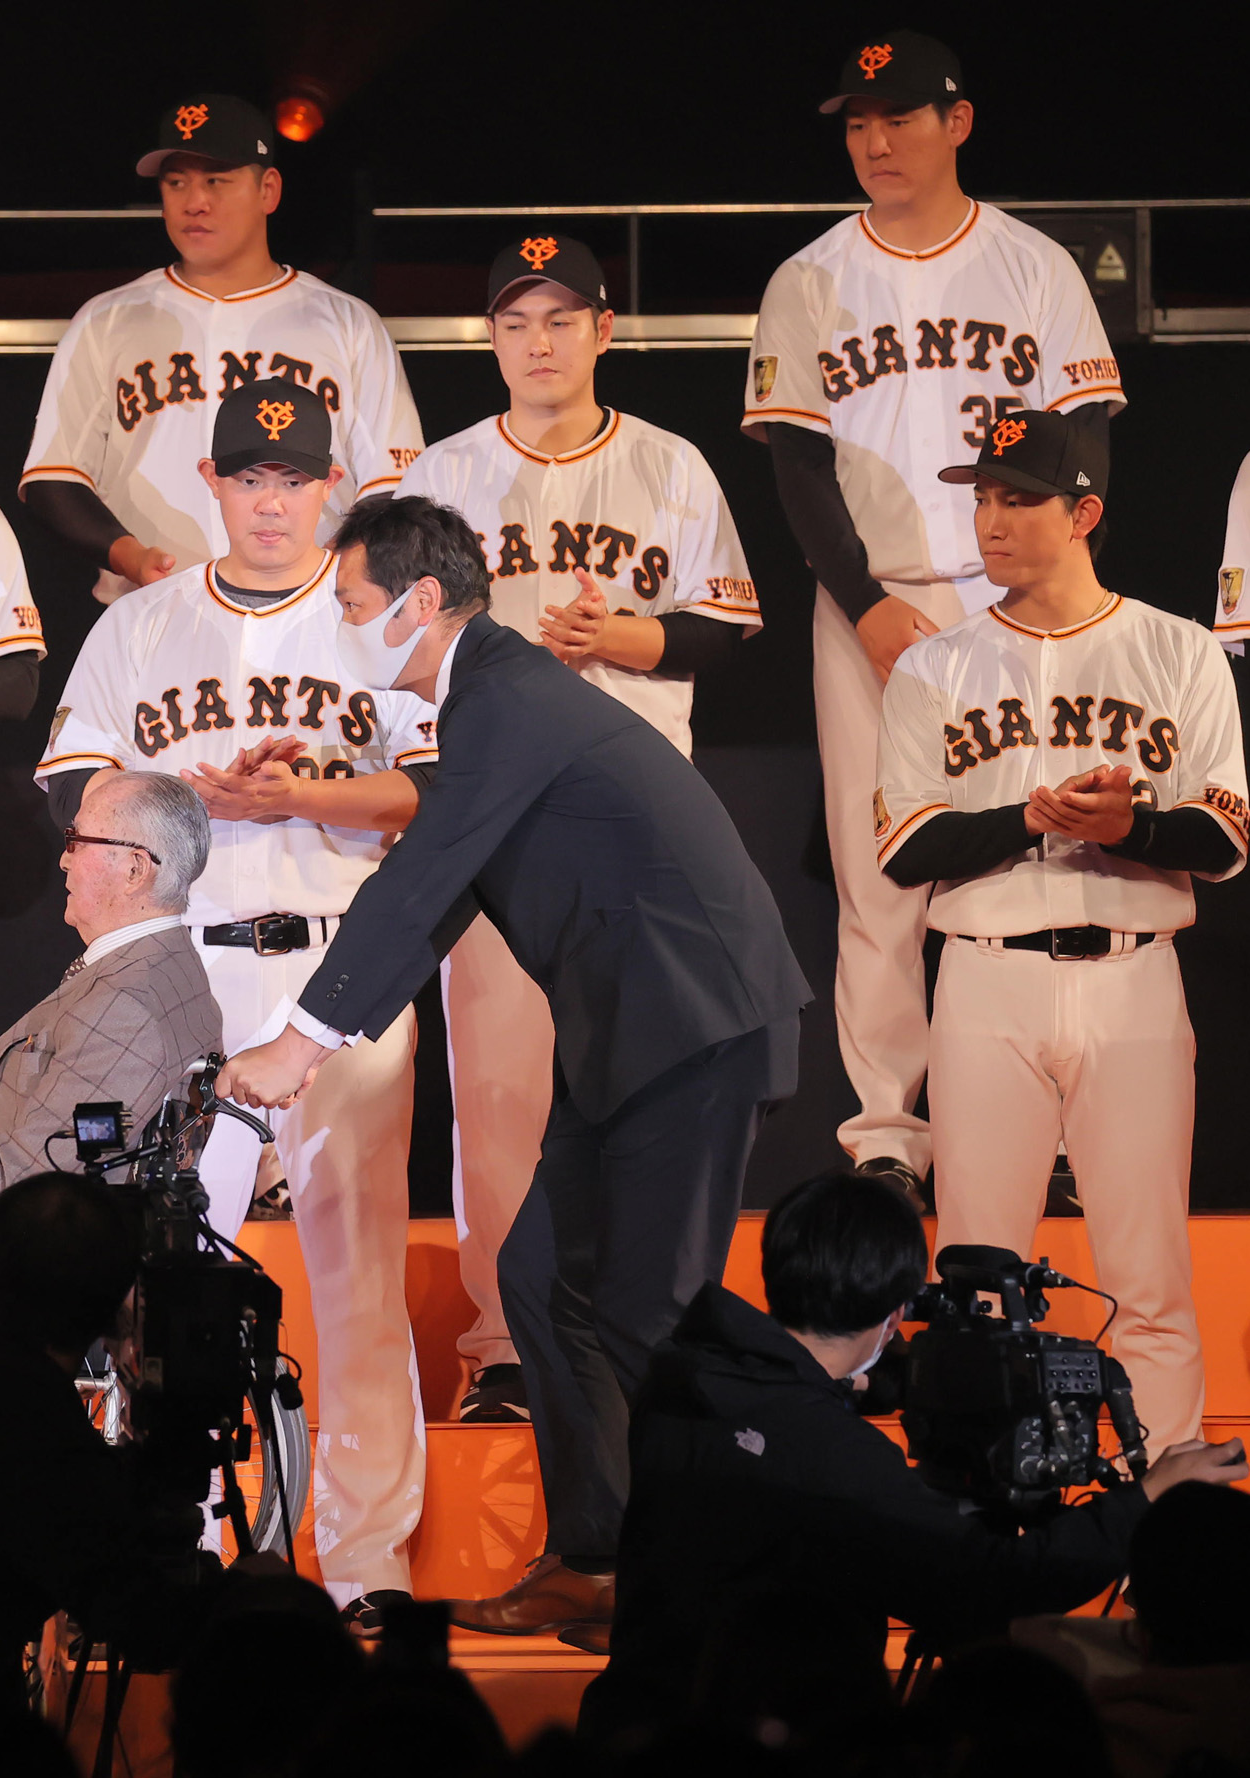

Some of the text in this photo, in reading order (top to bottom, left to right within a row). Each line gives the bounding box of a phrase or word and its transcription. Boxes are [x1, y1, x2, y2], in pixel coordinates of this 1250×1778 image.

[818, 318, 1040, 403] GIANTS
[706, 576, 759, 601] YOMIU
[134, 675, 377, 758] GIANTS
[944, 695, 1179, 778] GIANTS
